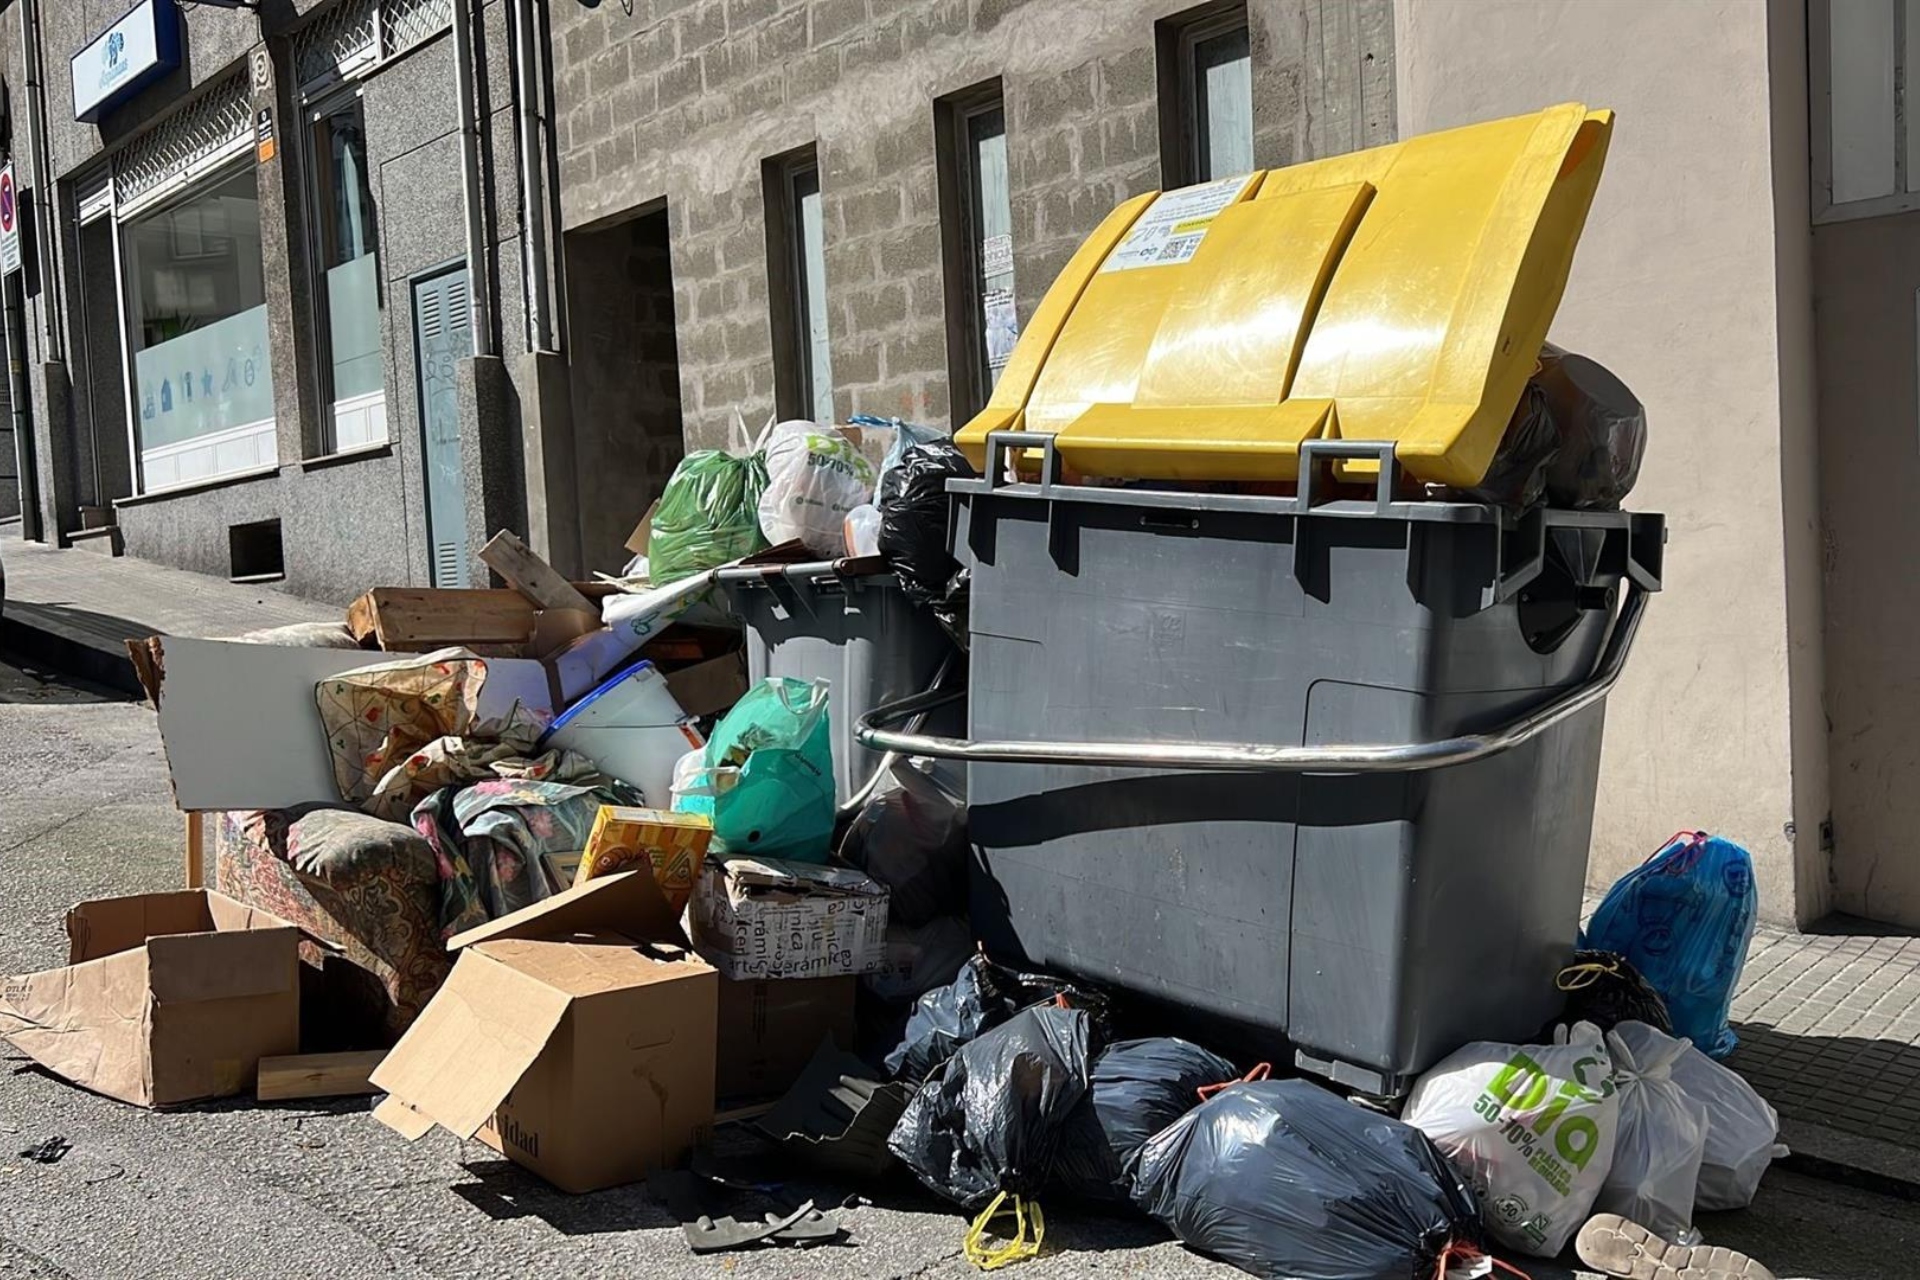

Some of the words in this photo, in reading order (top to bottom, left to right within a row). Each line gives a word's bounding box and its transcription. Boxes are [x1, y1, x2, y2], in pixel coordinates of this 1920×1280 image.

[807, 452, 855, 477] 50-70%
[1472, 1093, 1534, 1158] 50-70%
[1535, 1147, 1572, 1184] PLÁSTICO
[1501, 1203, 1519, 1218] 50
